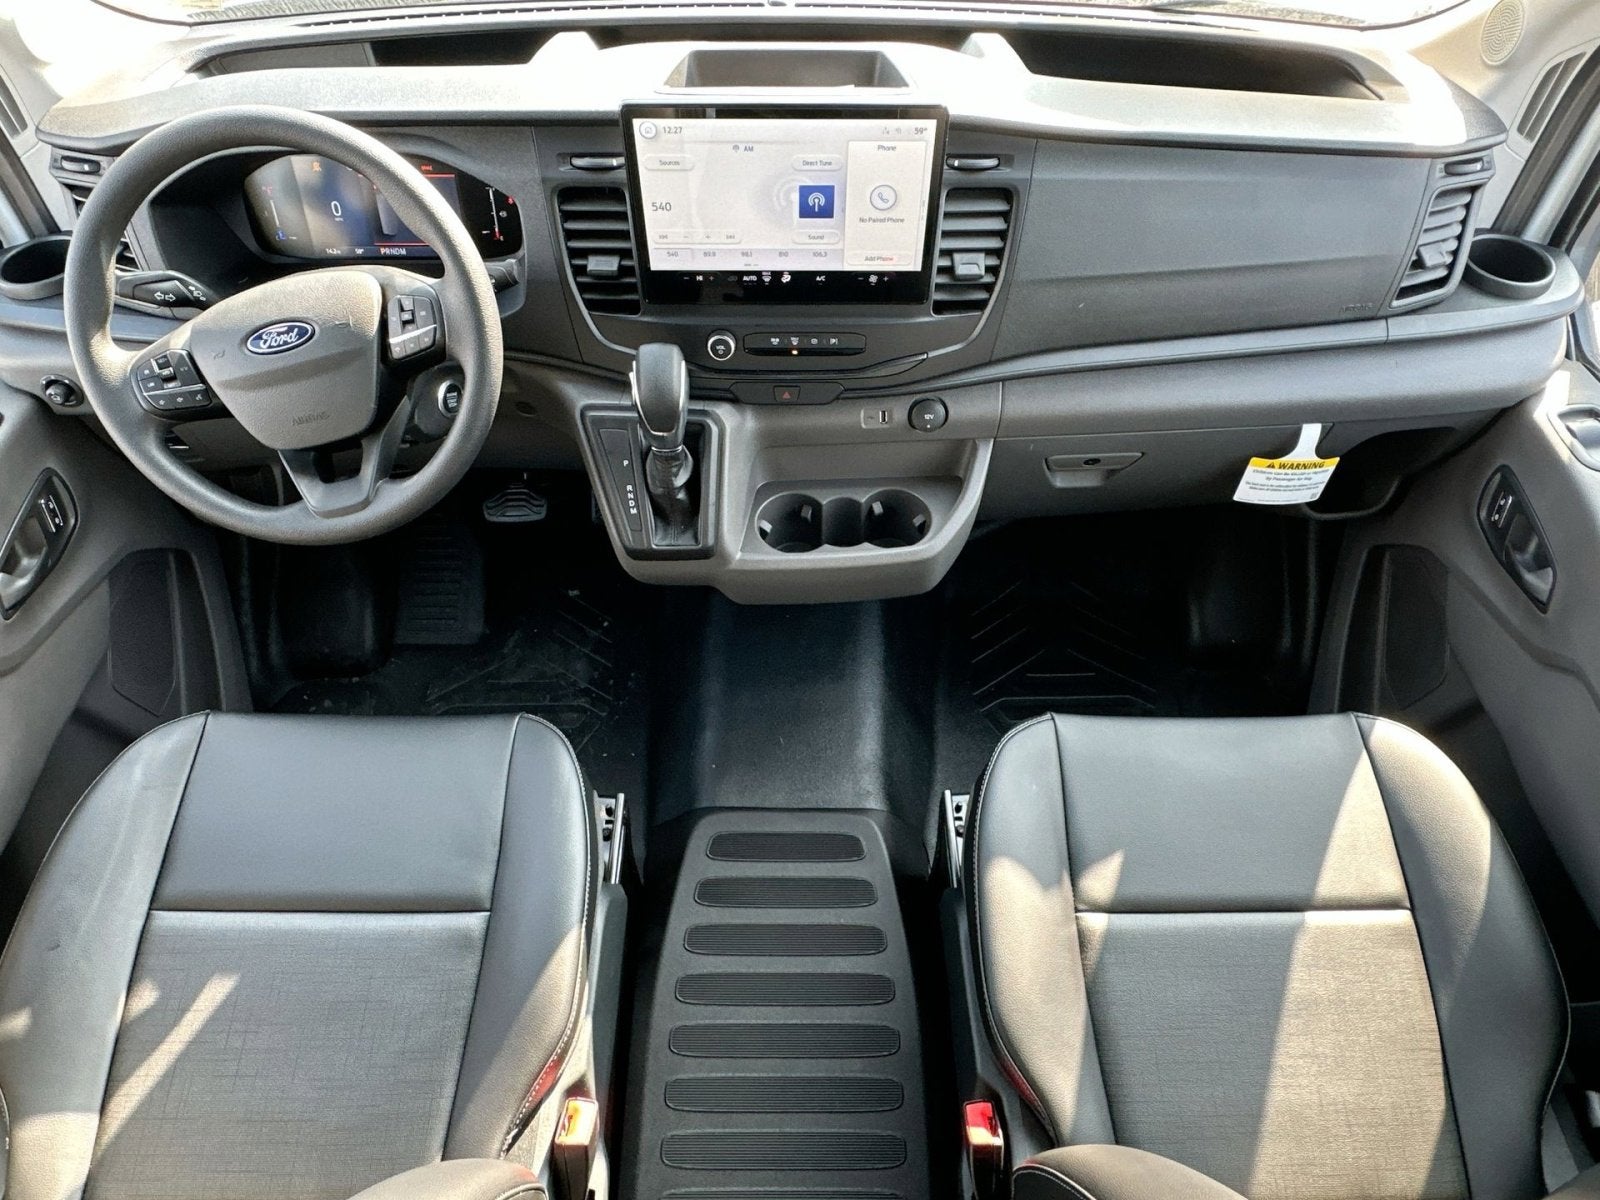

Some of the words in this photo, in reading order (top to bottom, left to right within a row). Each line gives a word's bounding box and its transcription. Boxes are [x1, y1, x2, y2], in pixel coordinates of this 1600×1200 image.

[877, 144, 897, 152] Phone
[331, 200, 342, 216] 0
[651, 202, 672, 212] 540
[260, 325, 299, 348] Ford
[1278, 460, 1325, 470] WARNING
